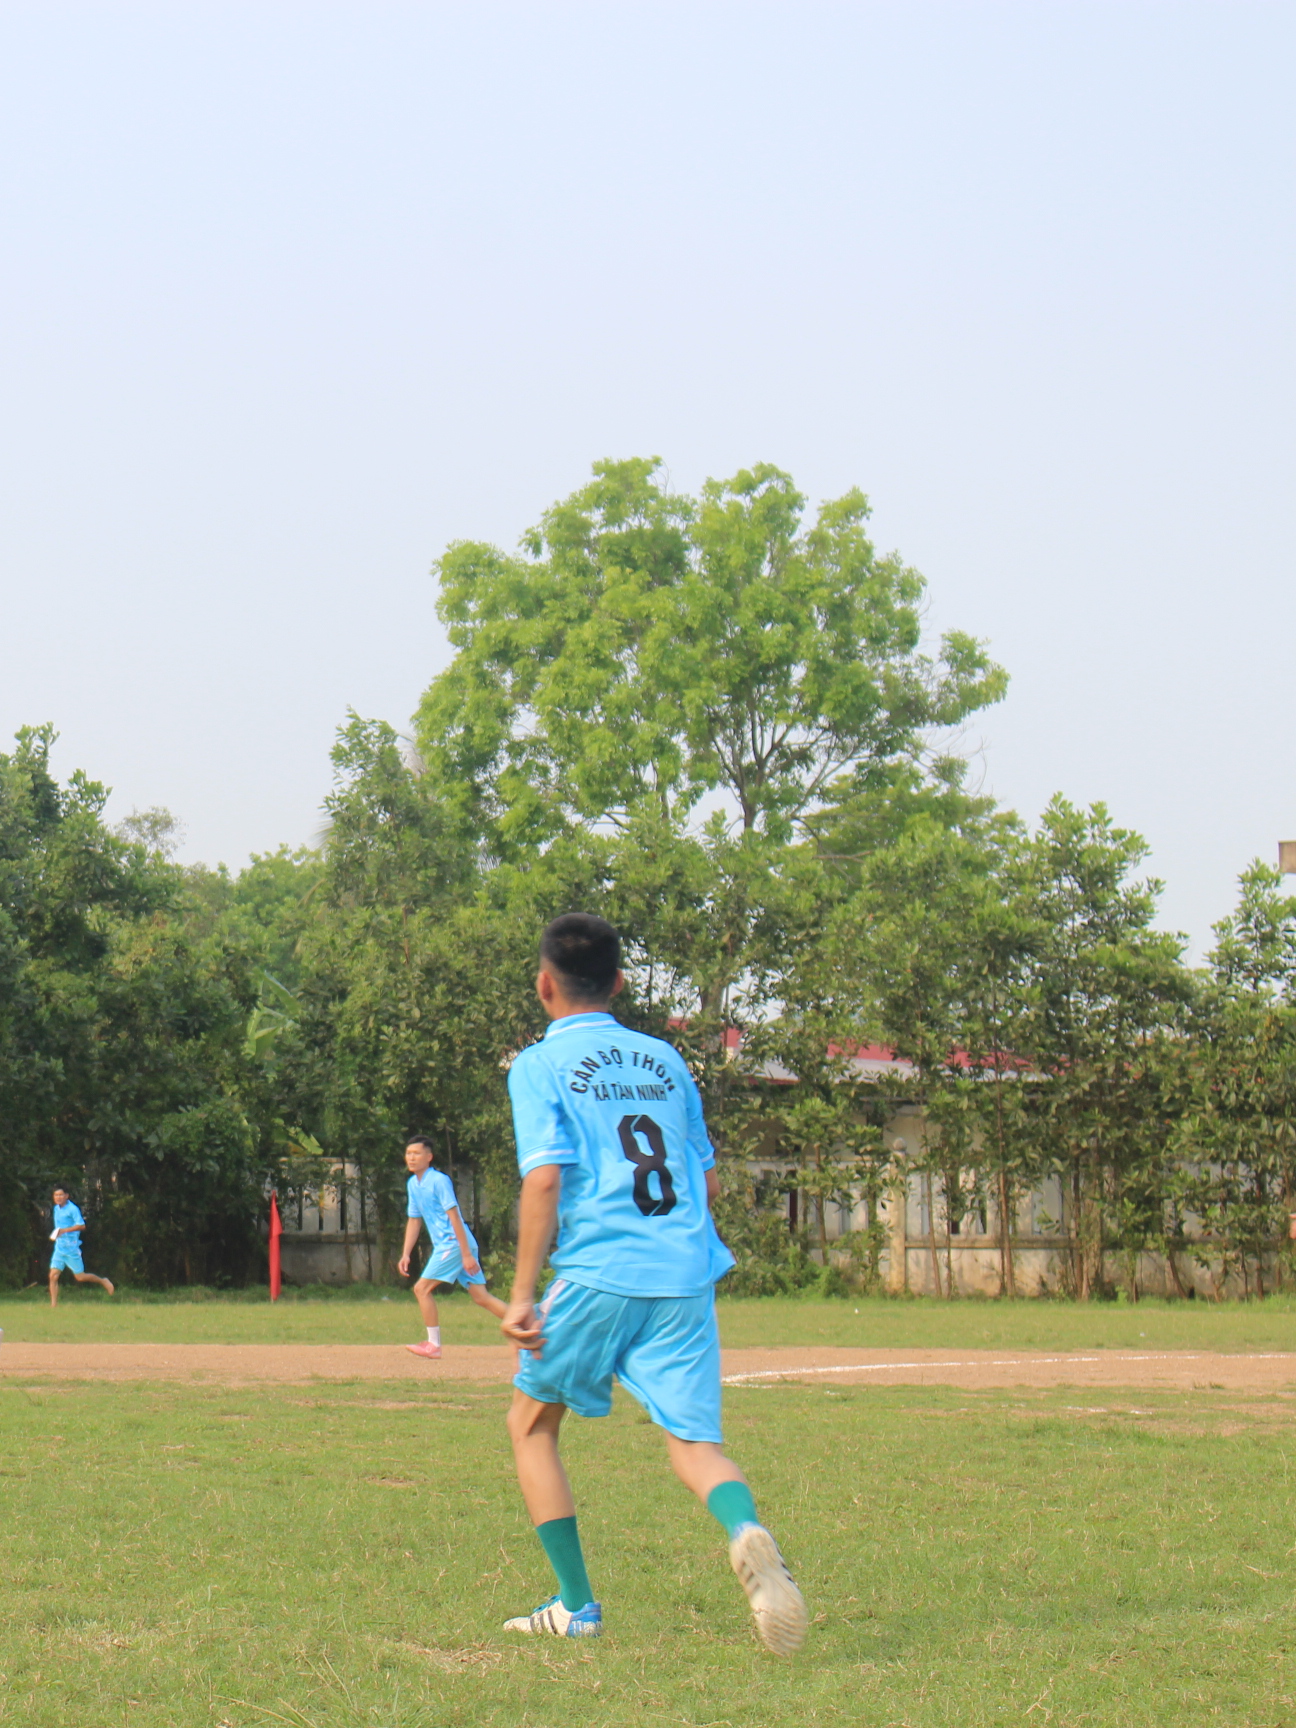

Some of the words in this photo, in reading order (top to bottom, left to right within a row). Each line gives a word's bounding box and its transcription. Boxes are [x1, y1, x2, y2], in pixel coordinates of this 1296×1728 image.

[597, 1045, 623, 1069] BỘ
[635, 1084, 668, 1102] NINH
[617, 1114, 677, 1216] 8
